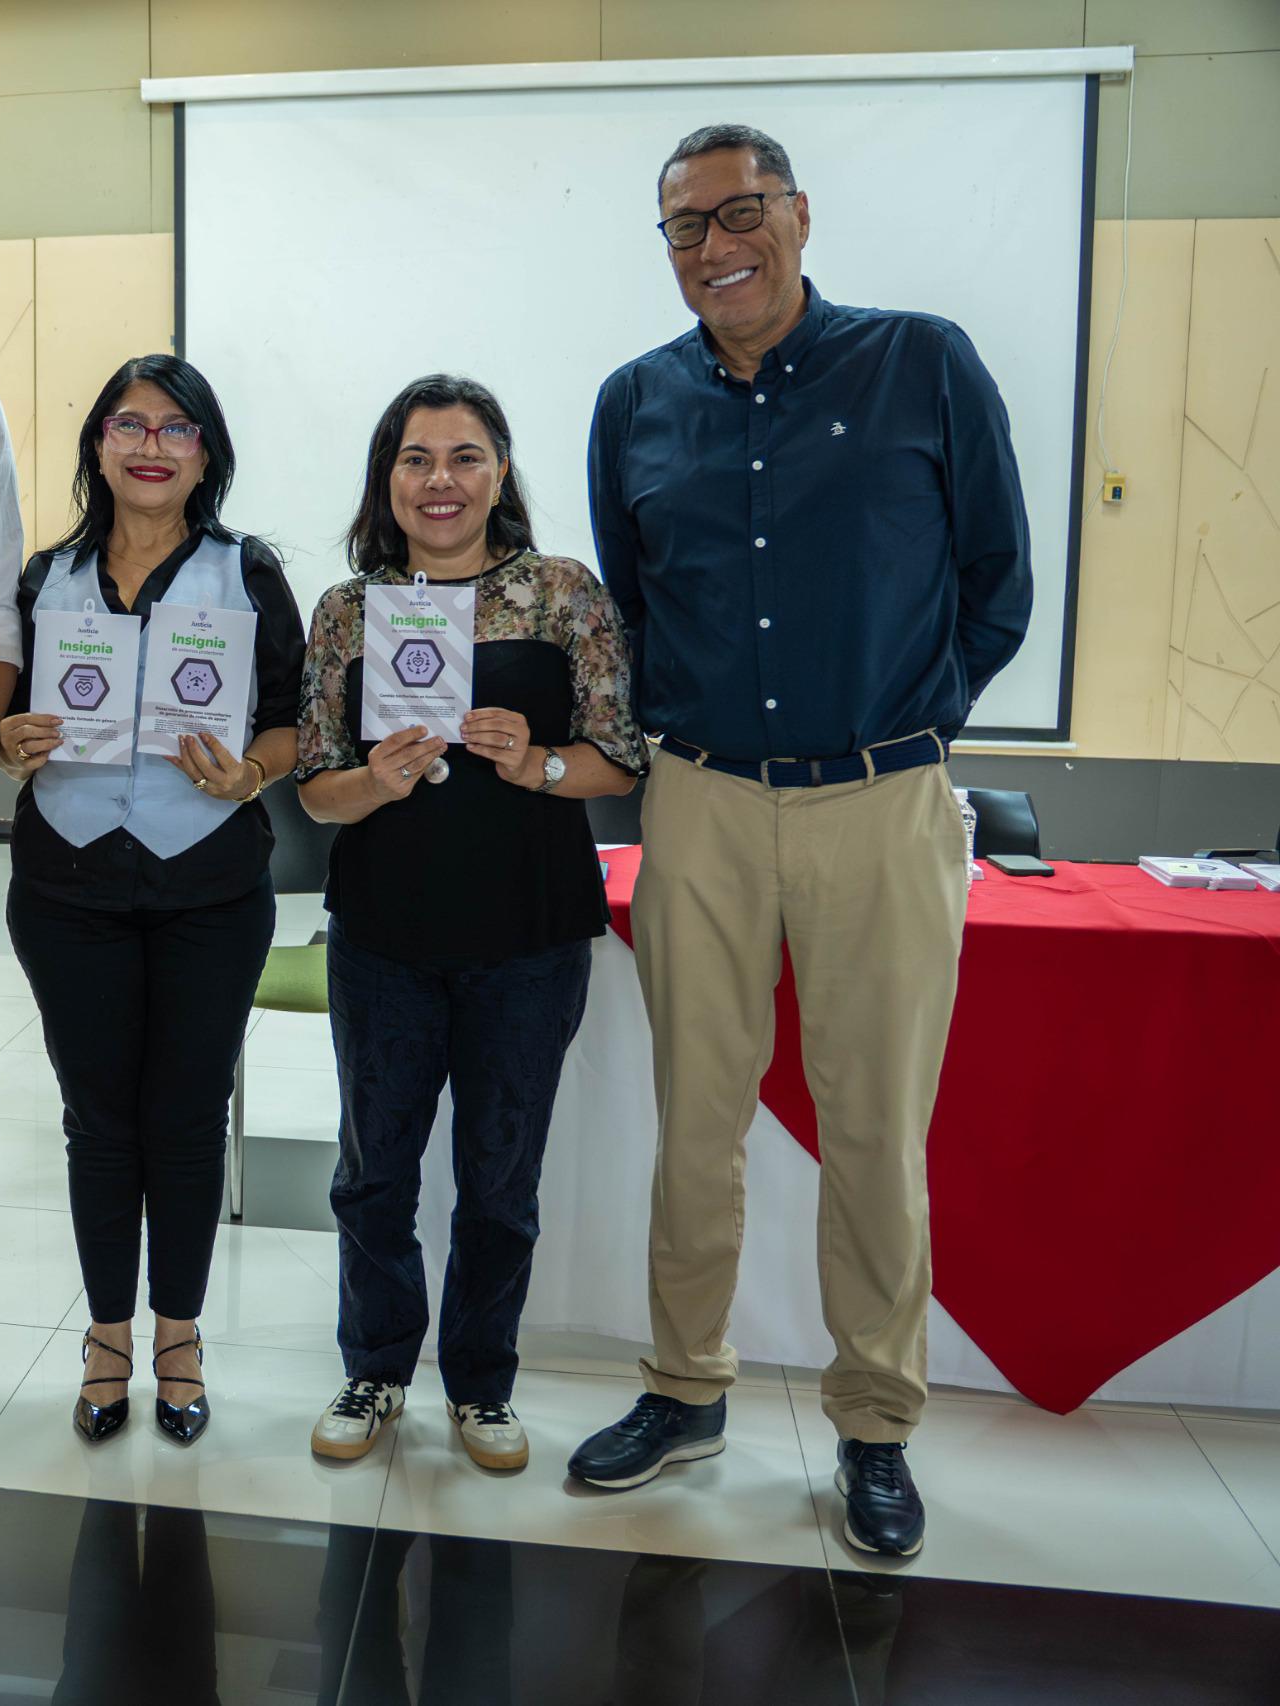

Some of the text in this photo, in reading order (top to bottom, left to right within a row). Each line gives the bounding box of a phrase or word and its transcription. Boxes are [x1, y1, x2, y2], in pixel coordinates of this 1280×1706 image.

[390, 614, 447, 629] Insignia
[59, 640, 113, 655] Insignia
[172, 632, 226, 649] Insignia
